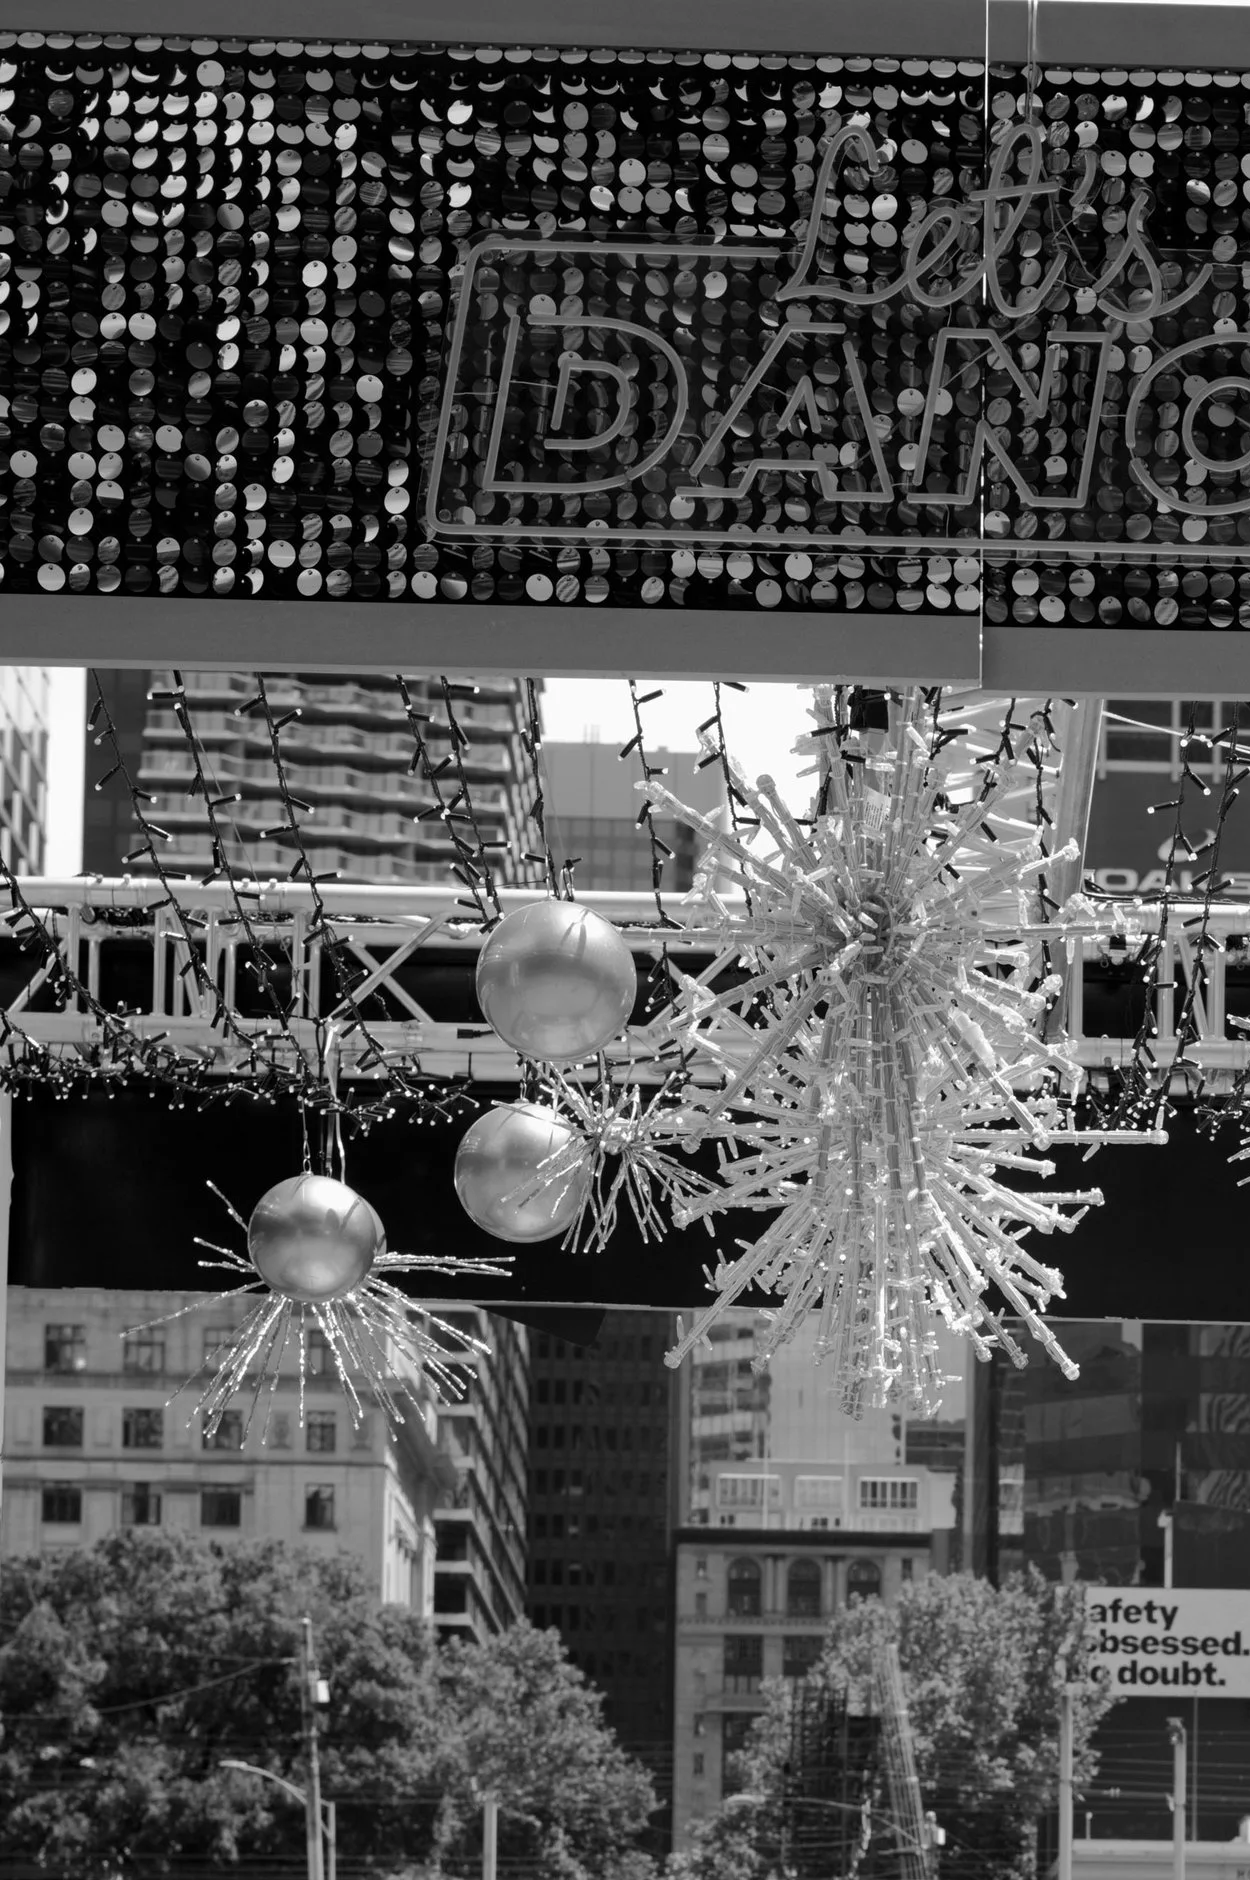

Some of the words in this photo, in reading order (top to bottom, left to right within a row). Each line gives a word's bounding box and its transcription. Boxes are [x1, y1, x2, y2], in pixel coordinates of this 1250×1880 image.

[776, 124, 1214, 323] Let's
[1088, 1598, 1179, 1631] afety
[1087, 1628, 1250, 1656] bsessed.
[1117, 1660, 1226, 1687] doubt.
